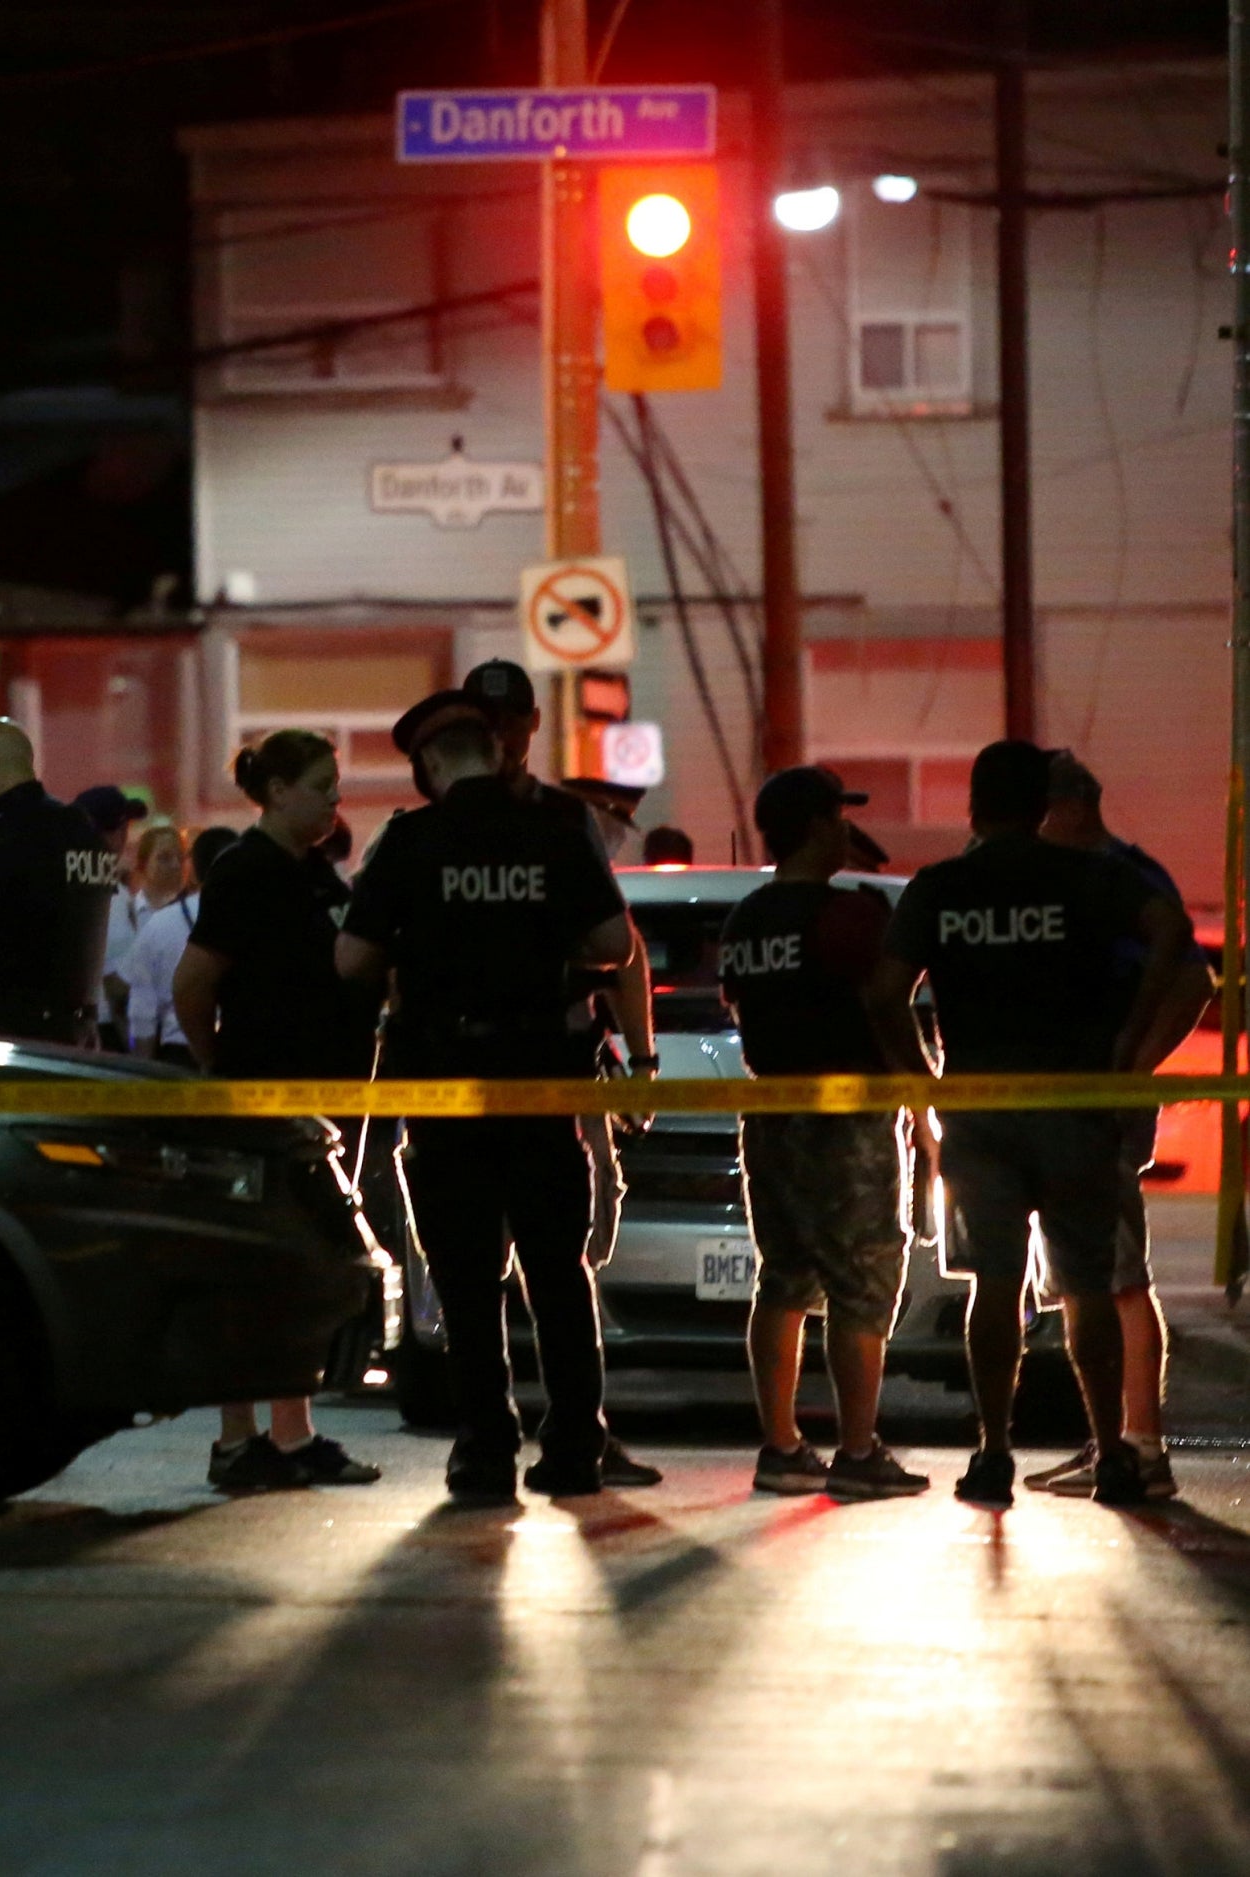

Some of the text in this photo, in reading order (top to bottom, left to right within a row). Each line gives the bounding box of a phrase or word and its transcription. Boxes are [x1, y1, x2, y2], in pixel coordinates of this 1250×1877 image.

[430, 99, 623, 143] Danforth
[442, 865, 546, 902] POLICE
[940, 905, 1065, 944] POLICE
[718, 934, 801, 977] POLICE
